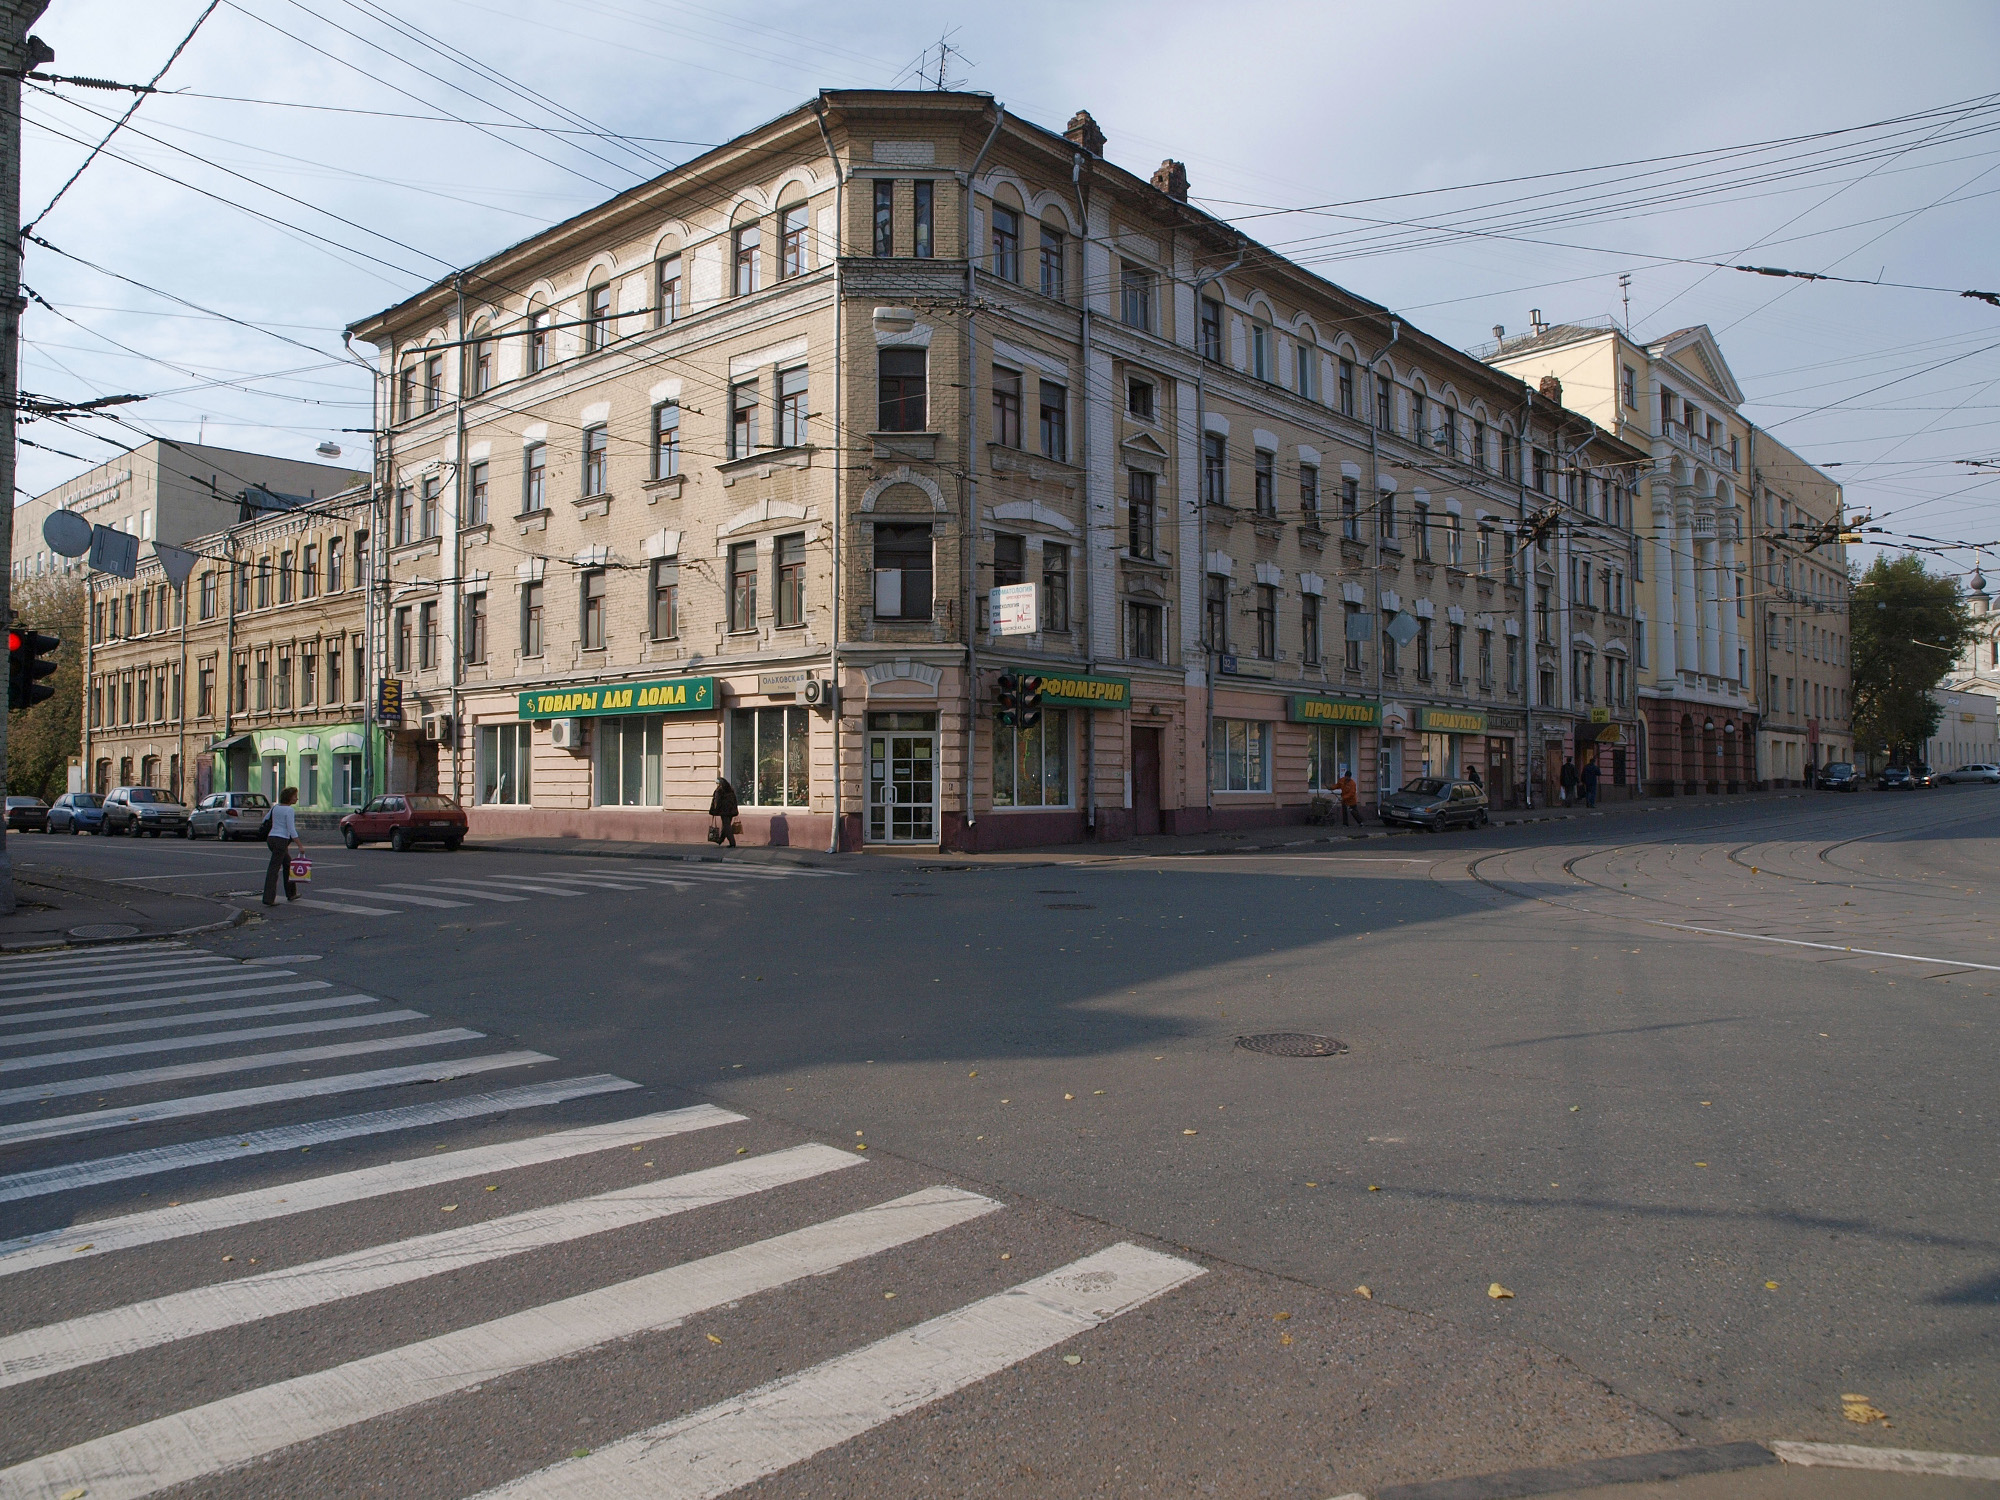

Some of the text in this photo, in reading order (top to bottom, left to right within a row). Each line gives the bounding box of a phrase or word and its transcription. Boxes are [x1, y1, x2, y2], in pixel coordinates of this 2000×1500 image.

[991, 586, 1033, 597] СТОМАТОЛОГИЯ
[762, 674, 805, 685] ОЛЬХОВСКАЯ
[1018, 675, 1124, 701] РФЮМЕРИЯ
[382, 680, 400, 713] САУНА
[537, 685, 686, 713] ТОВАРЫ ДЛЯ ДОМА
[1304, 701, 1374, 721] ПРОДУКТЫ
[1428, 712, 1482, 730] ПРОДУКТЫ
